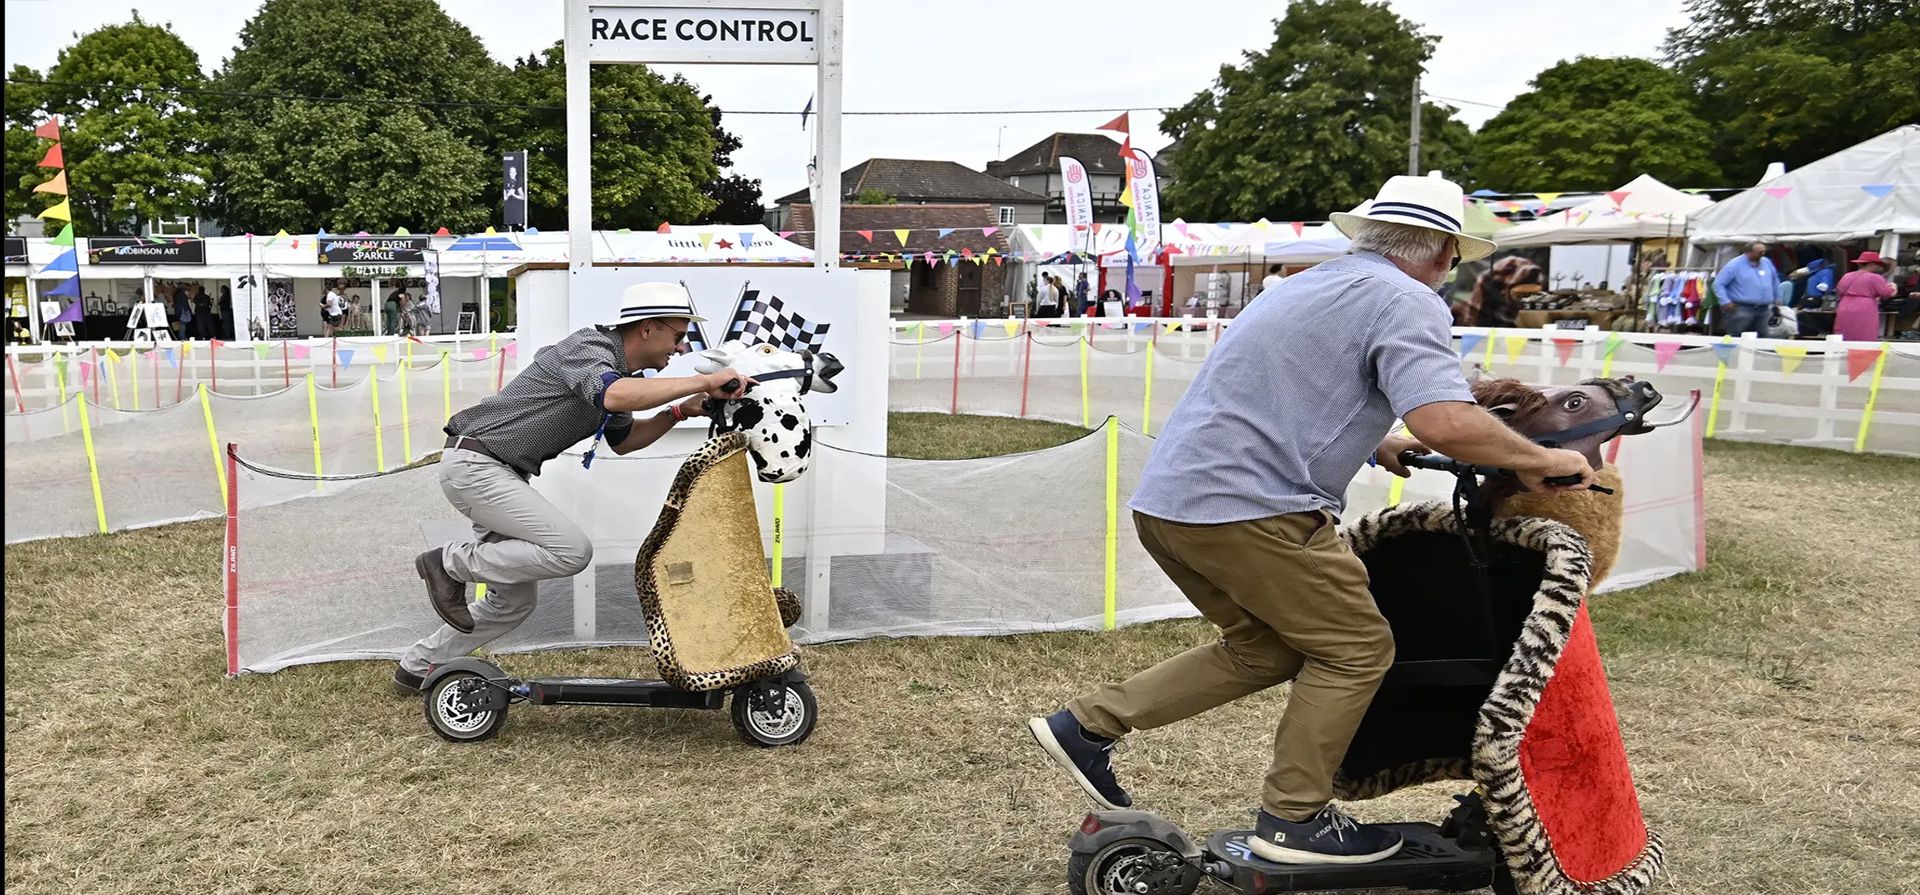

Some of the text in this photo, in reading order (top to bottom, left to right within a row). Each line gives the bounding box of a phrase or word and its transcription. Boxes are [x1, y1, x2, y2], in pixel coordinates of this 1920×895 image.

[591, 18, 814, 42] RACE CONTROL
[382, 240, 413, 249] EVENT
[123, 247, 162, 255] OBINSON
[164, 247, 180, 255] ART
[352, 251, 395, 260] SPARKLE
